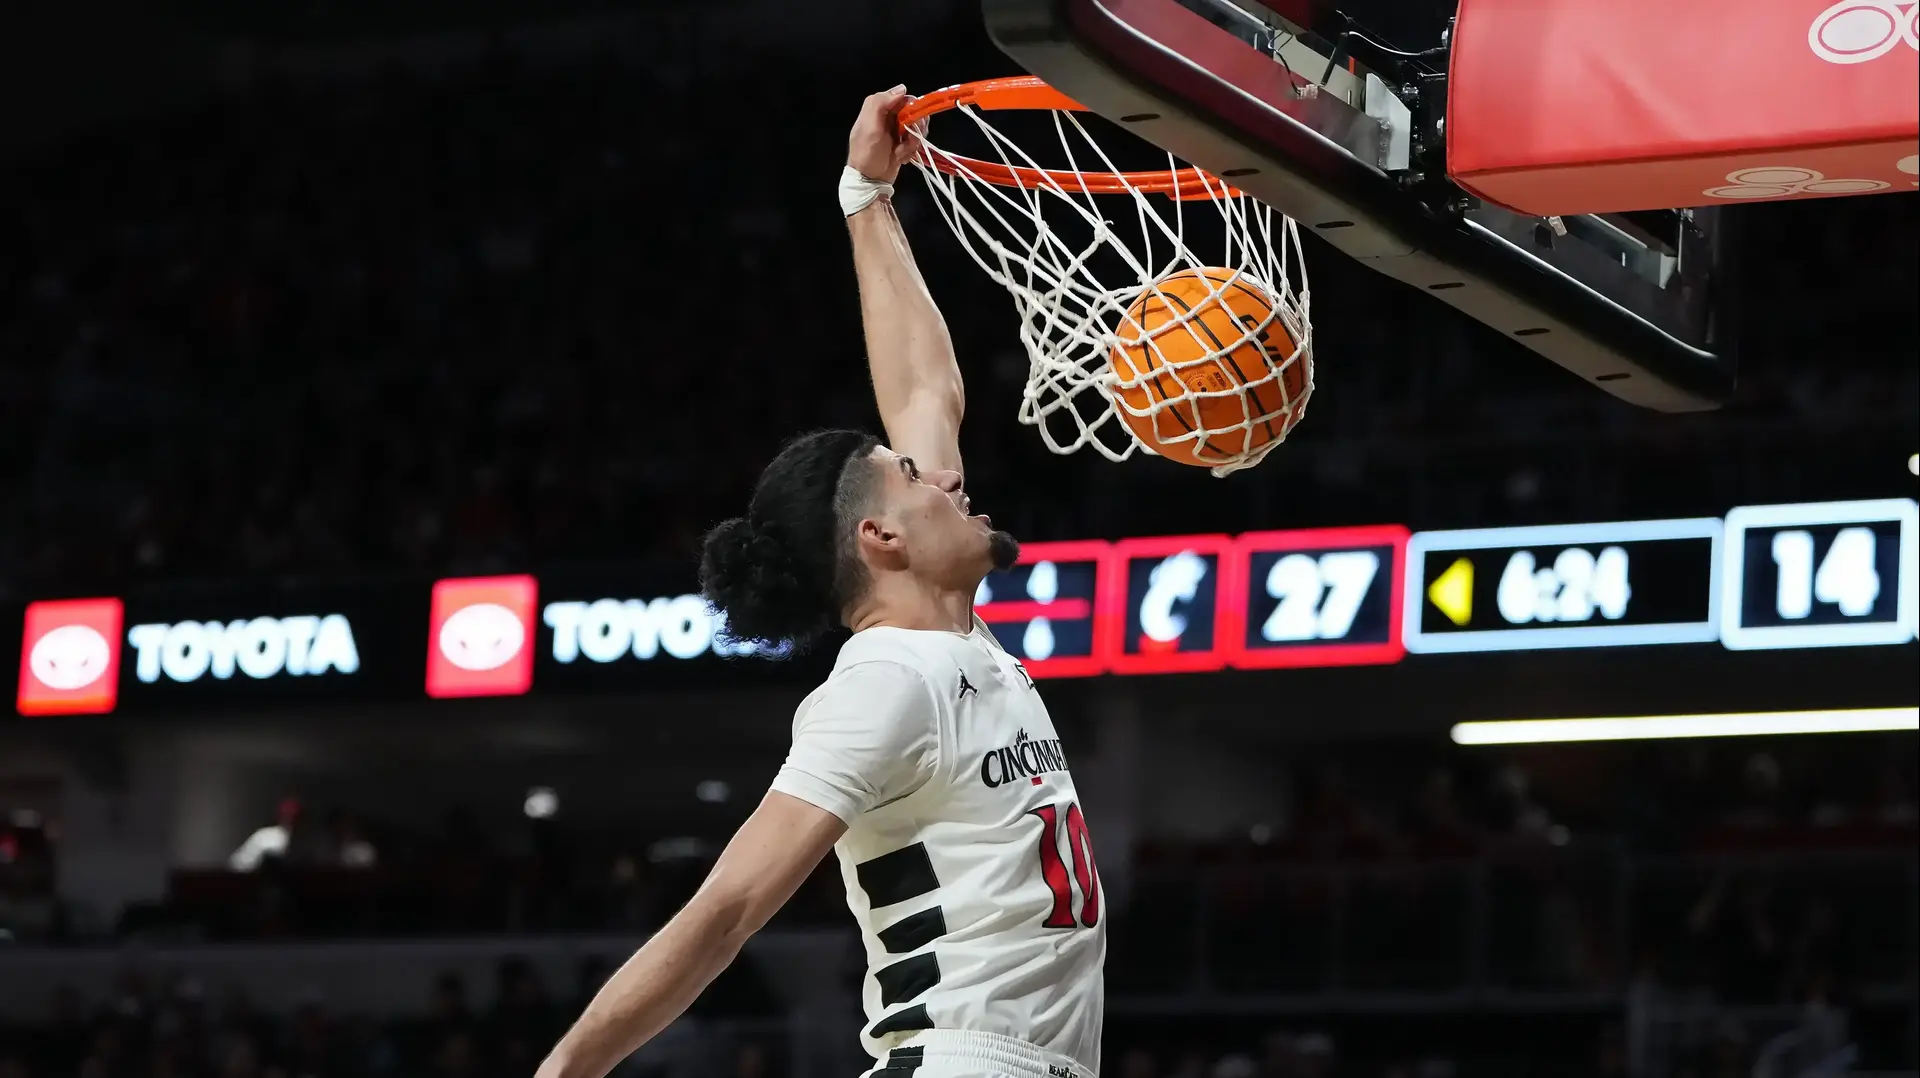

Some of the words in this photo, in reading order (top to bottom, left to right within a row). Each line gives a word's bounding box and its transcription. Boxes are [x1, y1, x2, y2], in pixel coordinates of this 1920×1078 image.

[1263, 551, 1379, 642] 27
[1498, 546, 1630, 623] 6:24
[1772, 527, 1880, 620] 14
[129, 614, 359, 683] TOYOTA
[544, 594, 793, 663] TOYO
[981, 737, 1068, 788] CINCINNA
[1027, 803, 1099, 929] 10
